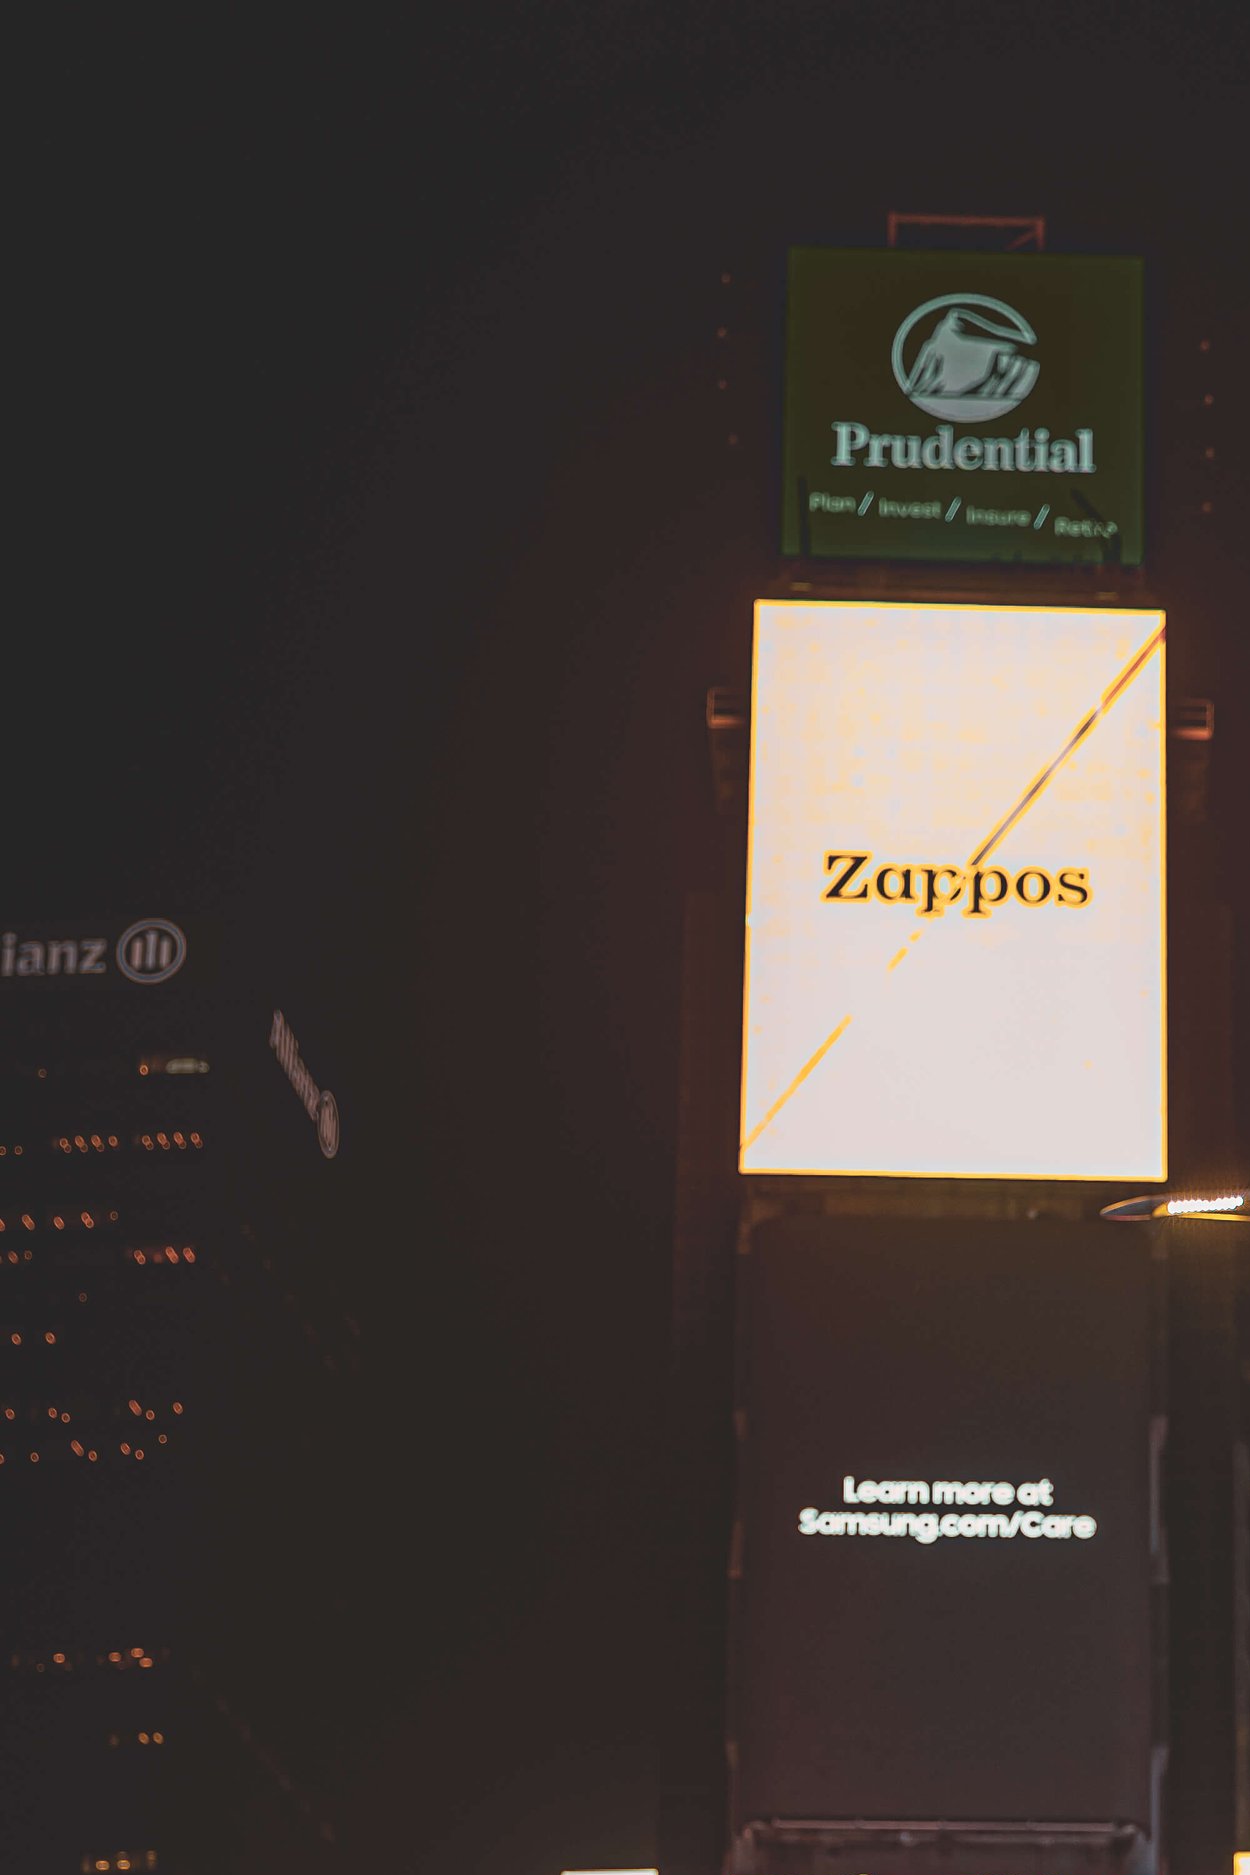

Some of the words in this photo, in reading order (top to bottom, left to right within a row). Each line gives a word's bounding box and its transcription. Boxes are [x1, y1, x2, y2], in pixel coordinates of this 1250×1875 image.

[831, 422, 1096, 473] Prudential
[809, 491, 857, 513] Plan
[879, 497, 942, 519] Invest
[966, 504, 1032, 527] Insure
[825, 854, 1089, 914] Zappos
[0, 932, 108, 977] ianz
[843, 1475, 930, 1504] Learn
[932, 1480, 1015, 1505] more
[1017, 1478, 1054, 1506] at
[798, 1506, 1098, 1545] Samsung.com/Care
